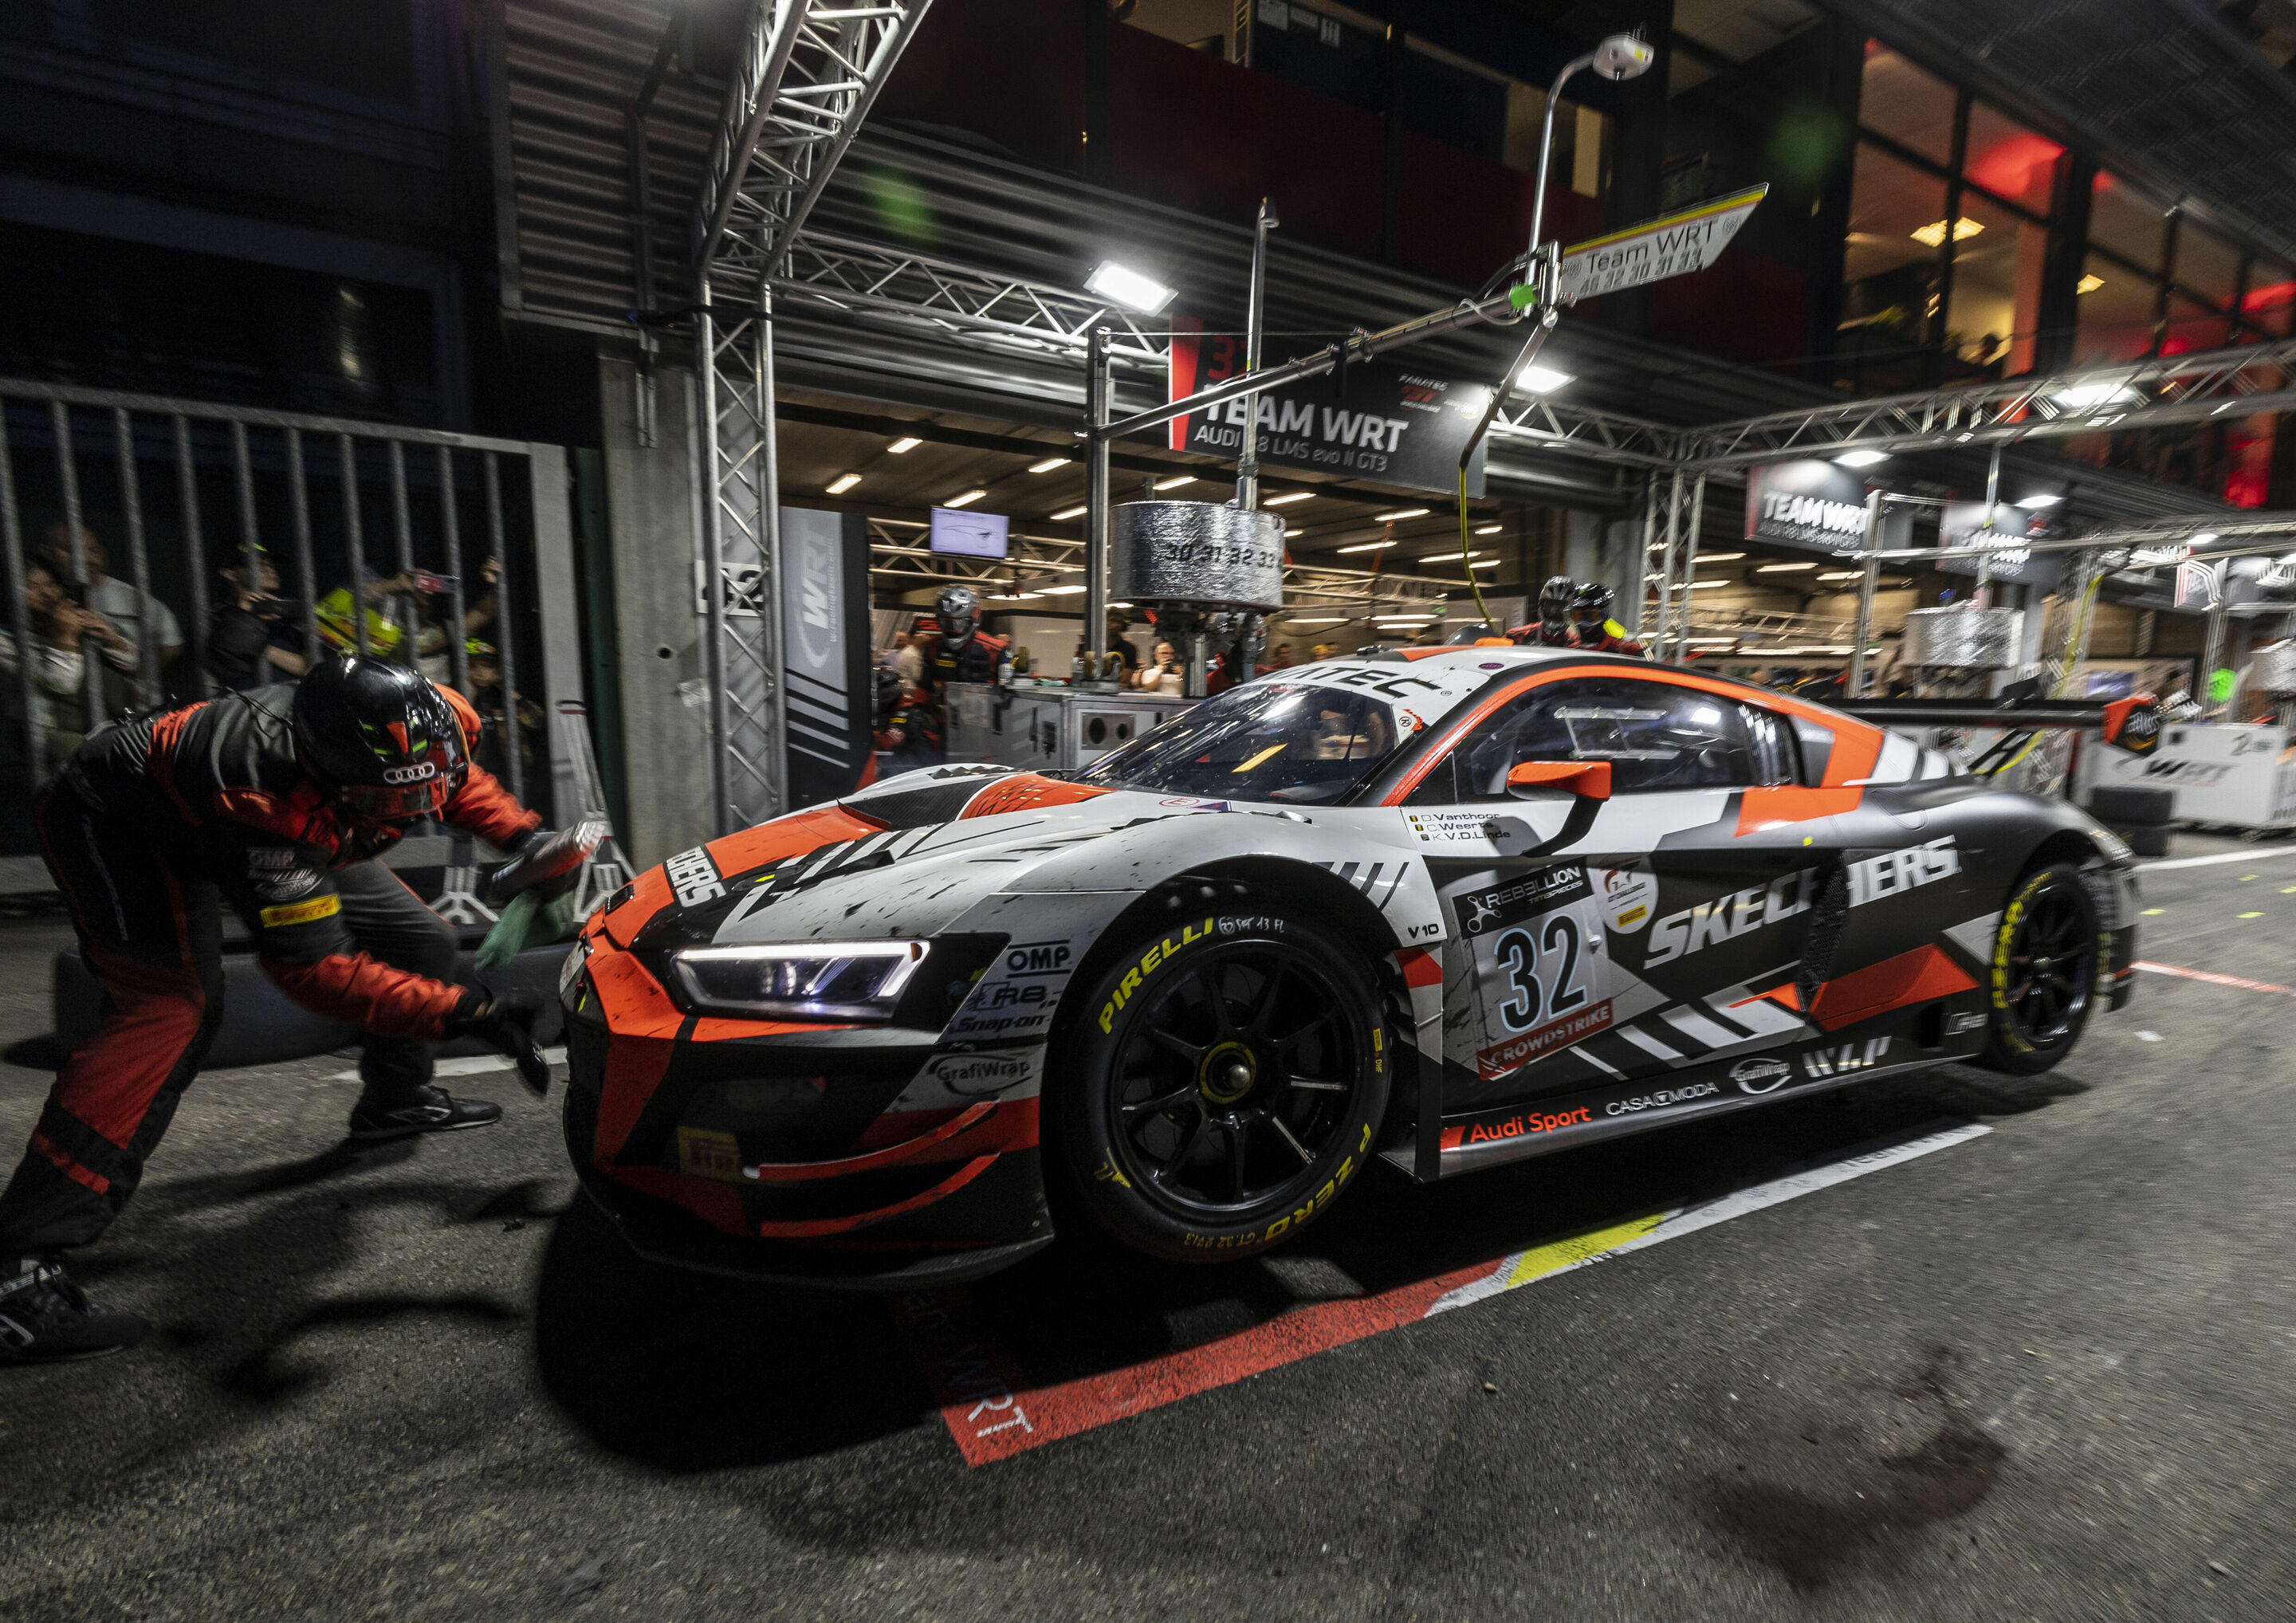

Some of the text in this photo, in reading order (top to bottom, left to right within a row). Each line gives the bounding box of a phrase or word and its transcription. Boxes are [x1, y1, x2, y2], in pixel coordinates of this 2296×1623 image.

[1586, 216, 1719, 275] Team WRT
[1204, 383, 1315, 438] TEAM
[1323, 406, 1409, 453] WRT
[1194, 424, 1240, 447] AUDI
[1272, 437, 1310, 459] LMS
[1312, 448, 1339, 463] evo
[1763, 490, 1825, 527] TEAM
[802, 523, 829, 629] WRT
[1421, 812, 1500, 823] D.Vanthoor
[1485, 865, 1581, 909] REBELLION
[1407, 922, 1440, 939] V10
[1006, 945, 1070, 975] OMP
[1098, 917, 1214, 1035] PIRELLI
[1494, 913, 1588, 1033] 32
[959, 1015, 1048, 1033] Snap-on
[1490, 1004, 1610, 1064] CROWDSTRIKE
[936, 1057, 1031, 1083] GrafiWrap
[1469, 1106, 1592, 1145] Audi Sport
